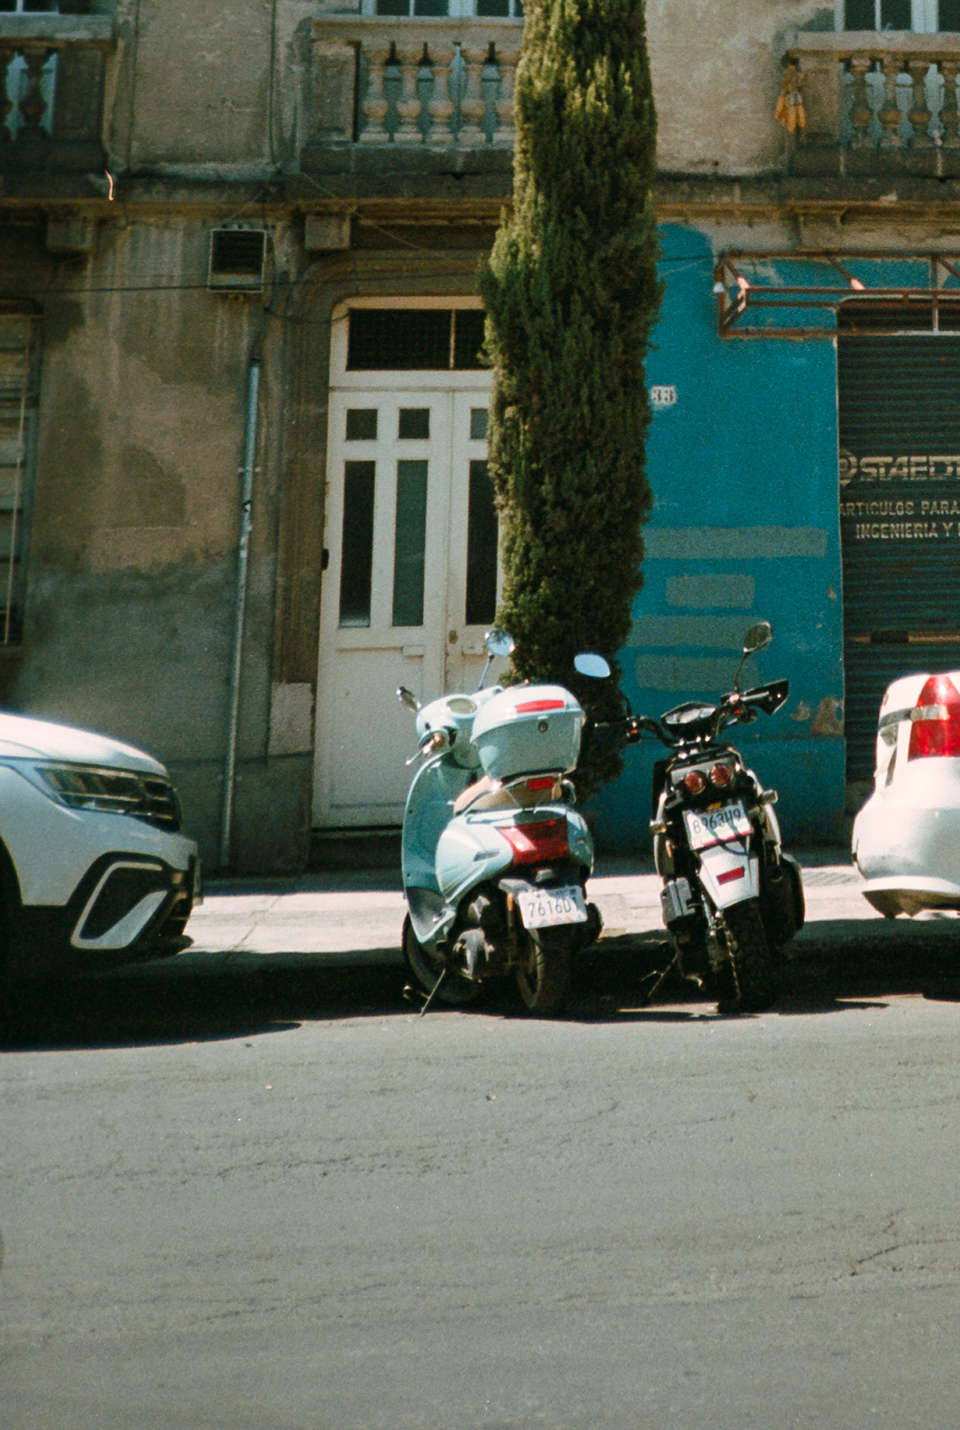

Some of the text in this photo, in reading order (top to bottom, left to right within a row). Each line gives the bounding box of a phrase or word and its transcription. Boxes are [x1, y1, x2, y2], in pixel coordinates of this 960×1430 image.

[920, 500, 960, 516] PARA
[855, 522, 939, 539] INGENIERIA
[942, 521, 953, 538] Y
